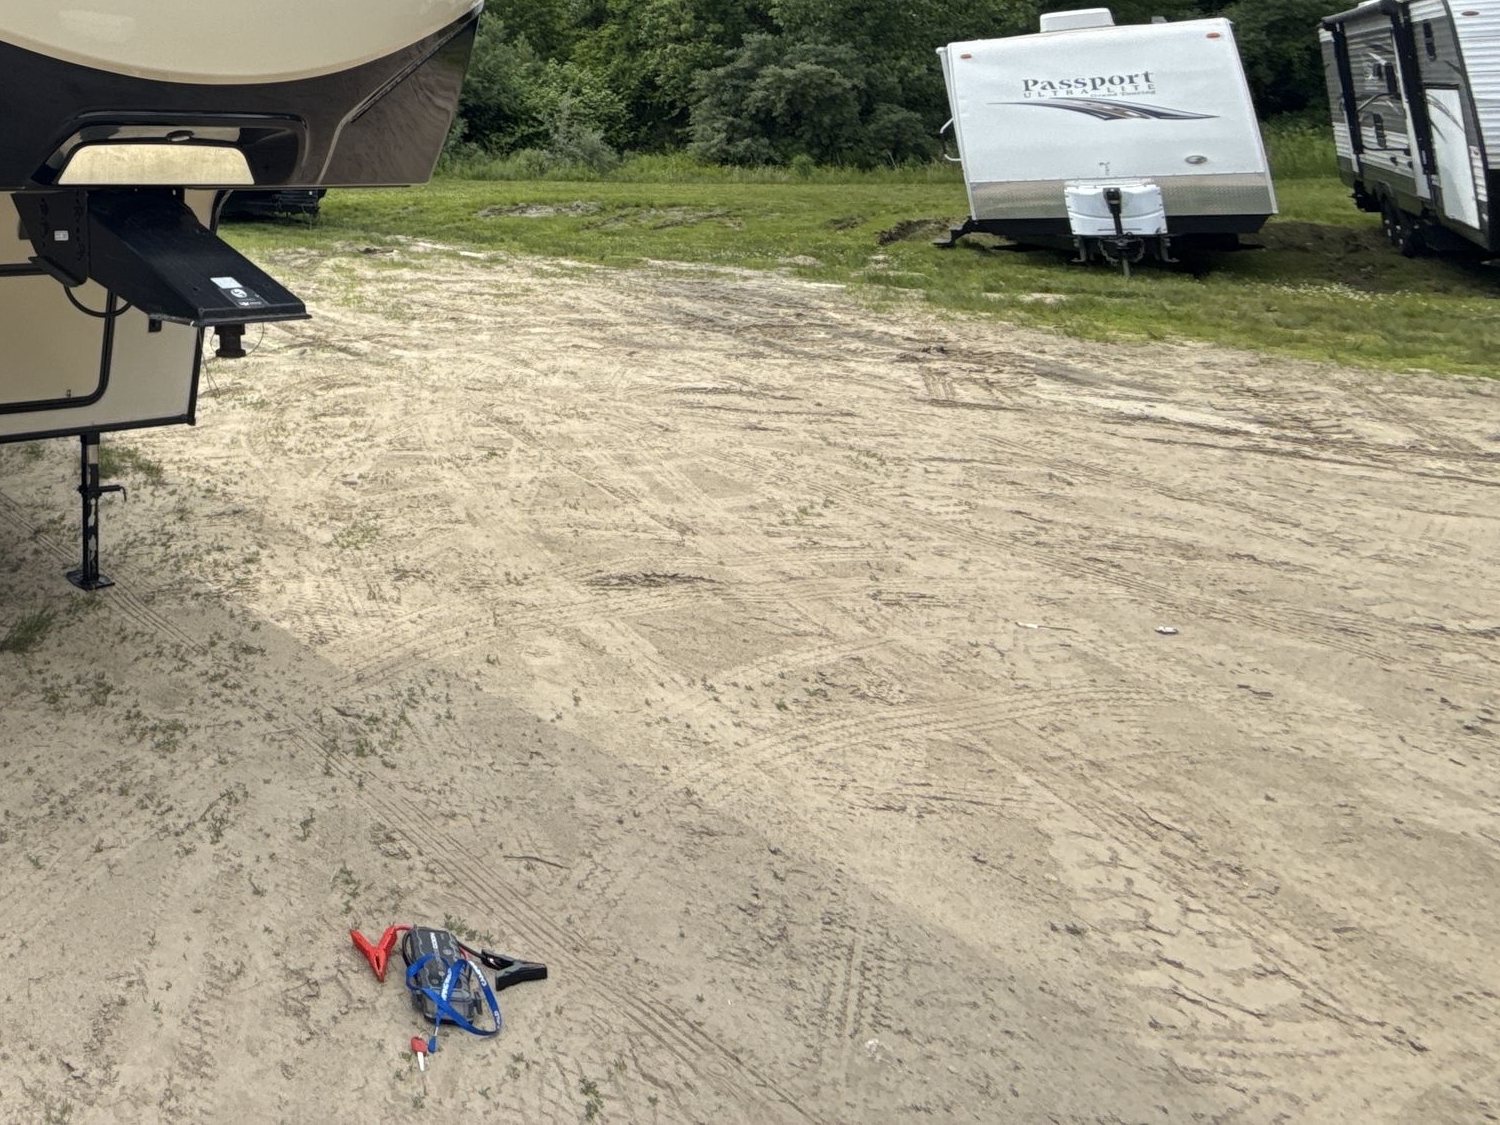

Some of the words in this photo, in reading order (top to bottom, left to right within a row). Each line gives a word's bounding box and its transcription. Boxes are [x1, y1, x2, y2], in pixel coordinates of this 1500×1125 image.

[1021, 70, 1155, 92] Passport
[1023, 87, 1089, 99] ULTRA
[1106, 82, 1157, 93] LITE
